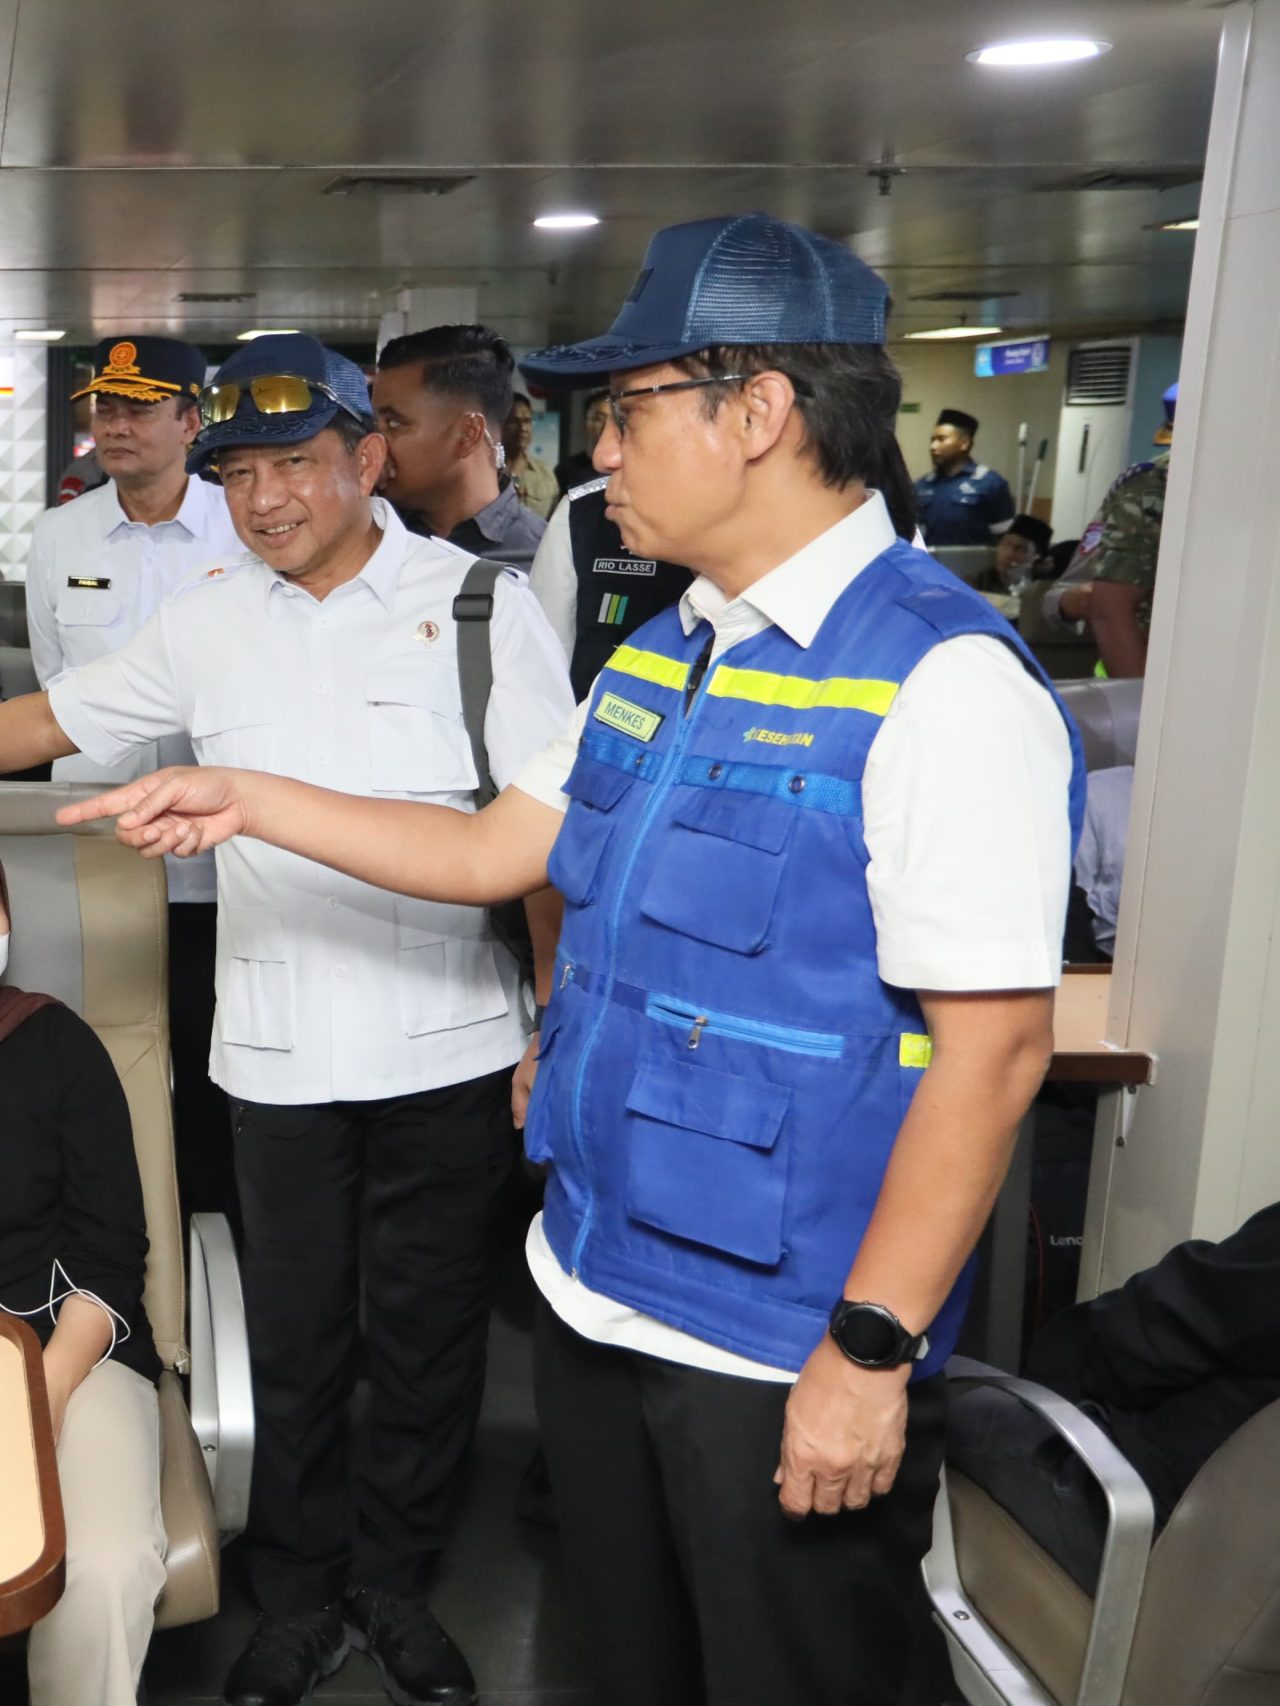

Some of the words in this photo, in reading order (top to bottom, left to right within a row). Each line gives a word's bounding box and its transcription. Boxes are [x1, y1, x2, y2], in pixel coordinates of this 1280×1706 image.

[598, 561, 615, 570] RIO
[618, 562, 652, 572] LASSE
[604, 701, 646, 730] MENKES
